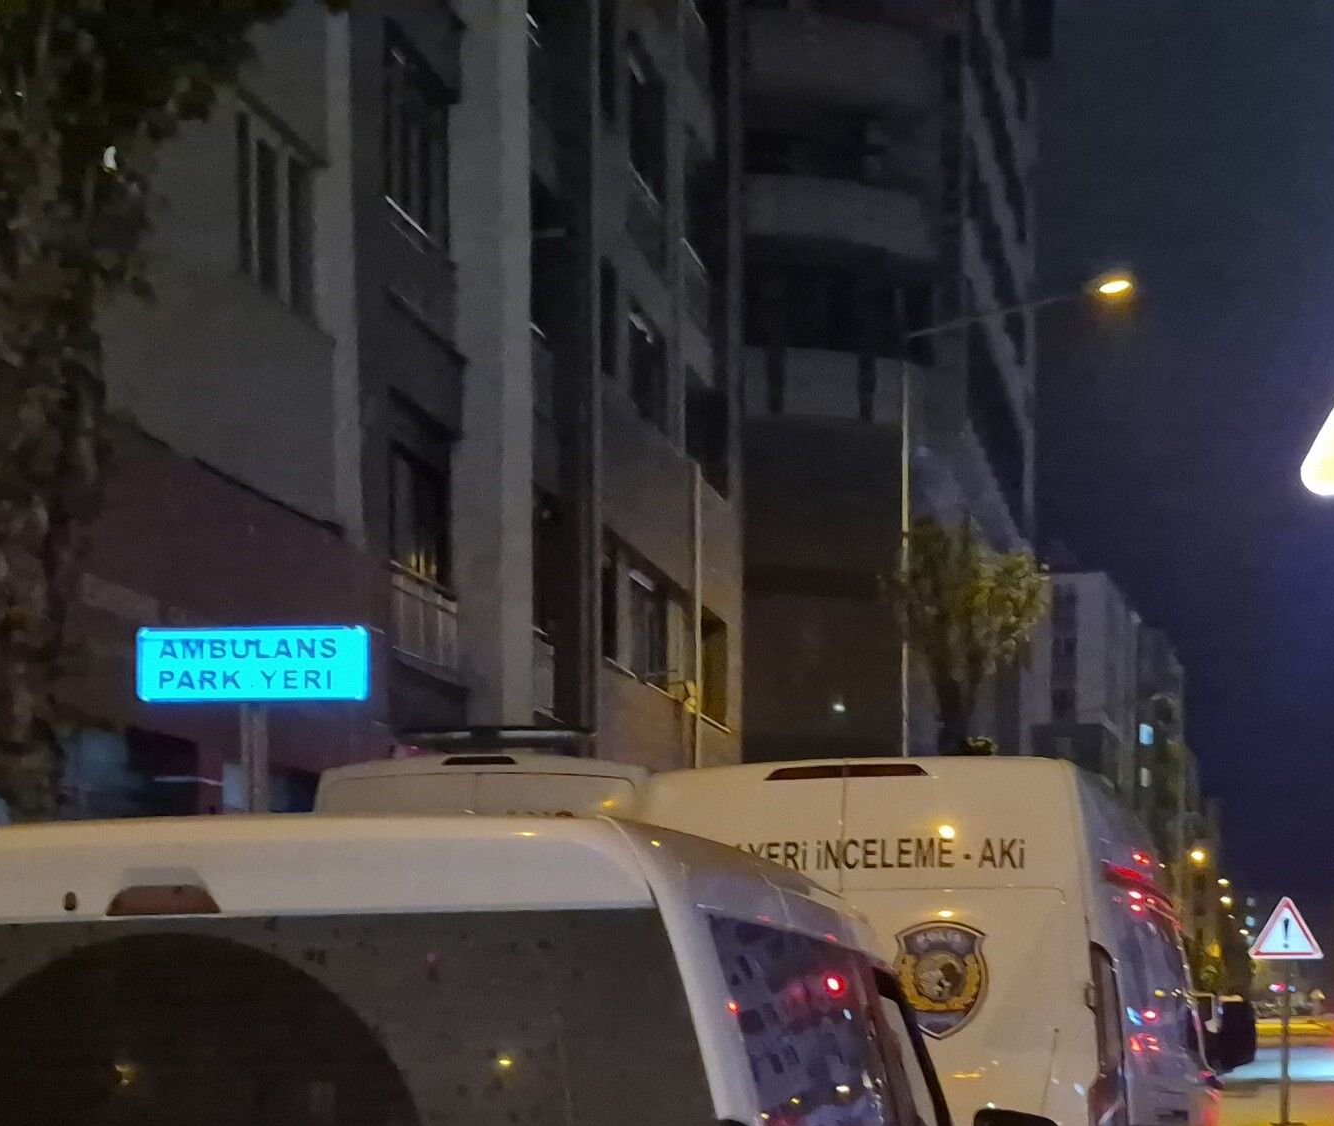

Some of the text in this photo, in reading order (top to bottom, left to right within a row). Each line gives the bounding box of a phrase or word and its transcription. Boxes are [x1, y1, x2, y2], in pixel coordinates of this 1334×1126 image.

[158, 638, 338, 660] AMBULANS
[158, 668, 332, 690] PARK YERI
